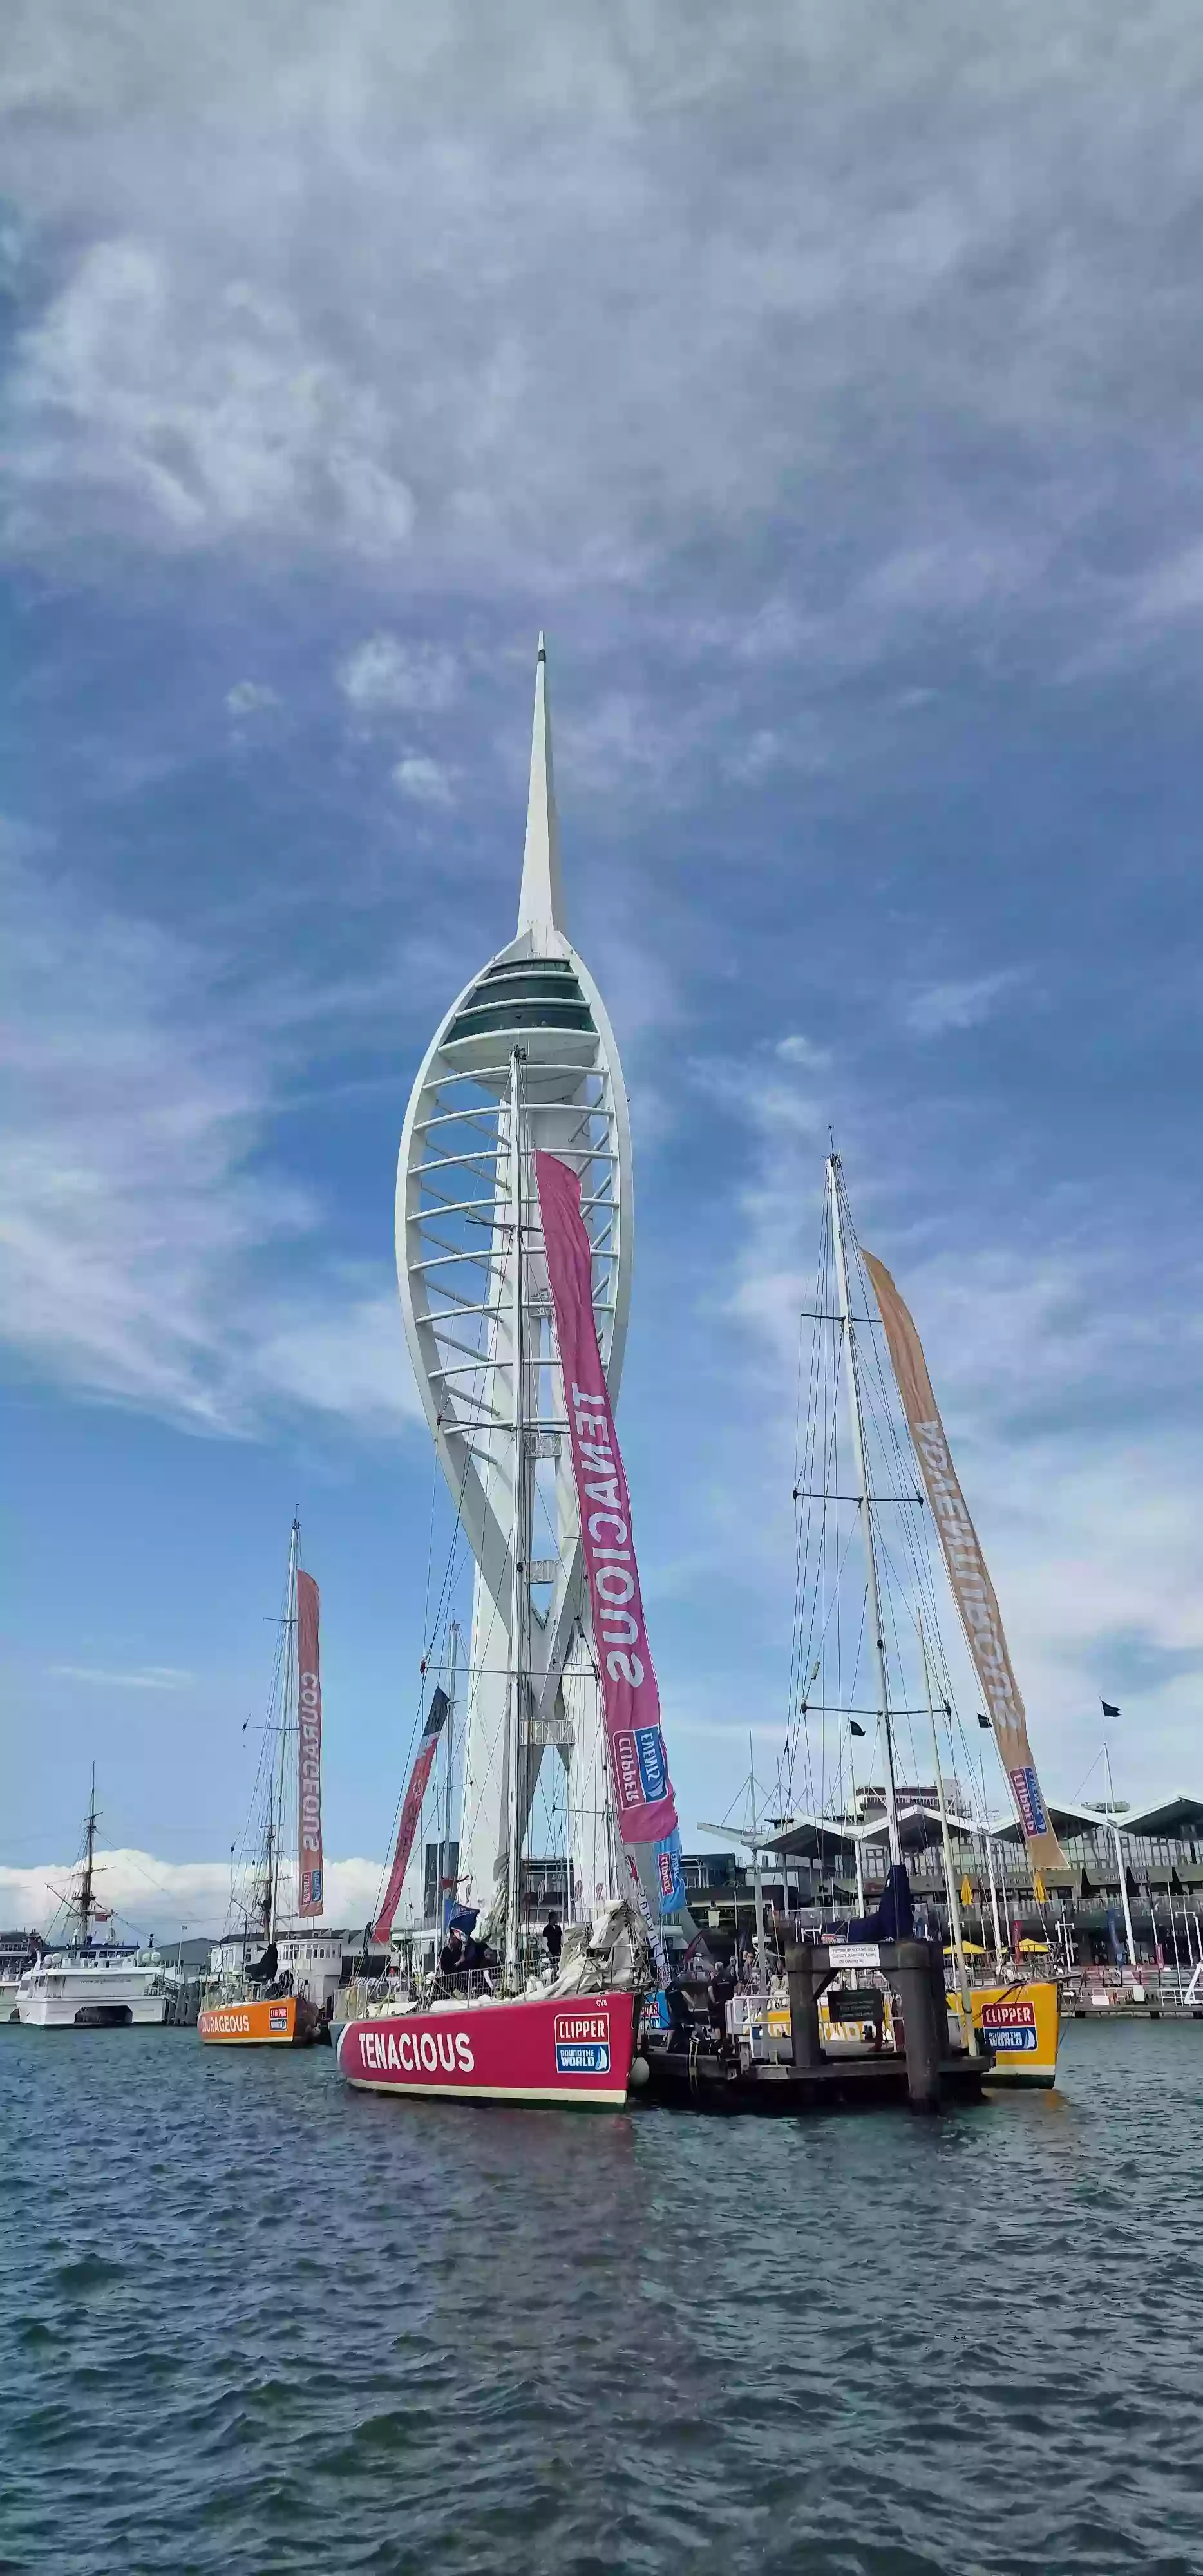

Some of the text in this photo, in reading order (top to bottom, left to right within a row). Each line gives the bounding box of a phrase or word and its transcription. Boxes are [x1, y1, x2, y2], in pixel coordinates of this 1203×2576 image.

[985, 2007, 1032, 2023] CLIPPER
[559, 2020, 605, 2038] CLIPPER
[989, 2037, 1023, 2047] WORLD
[359, 2033, 475, 2072] TENACIOUS
[560, 2056, 595, 2067] WORLD
